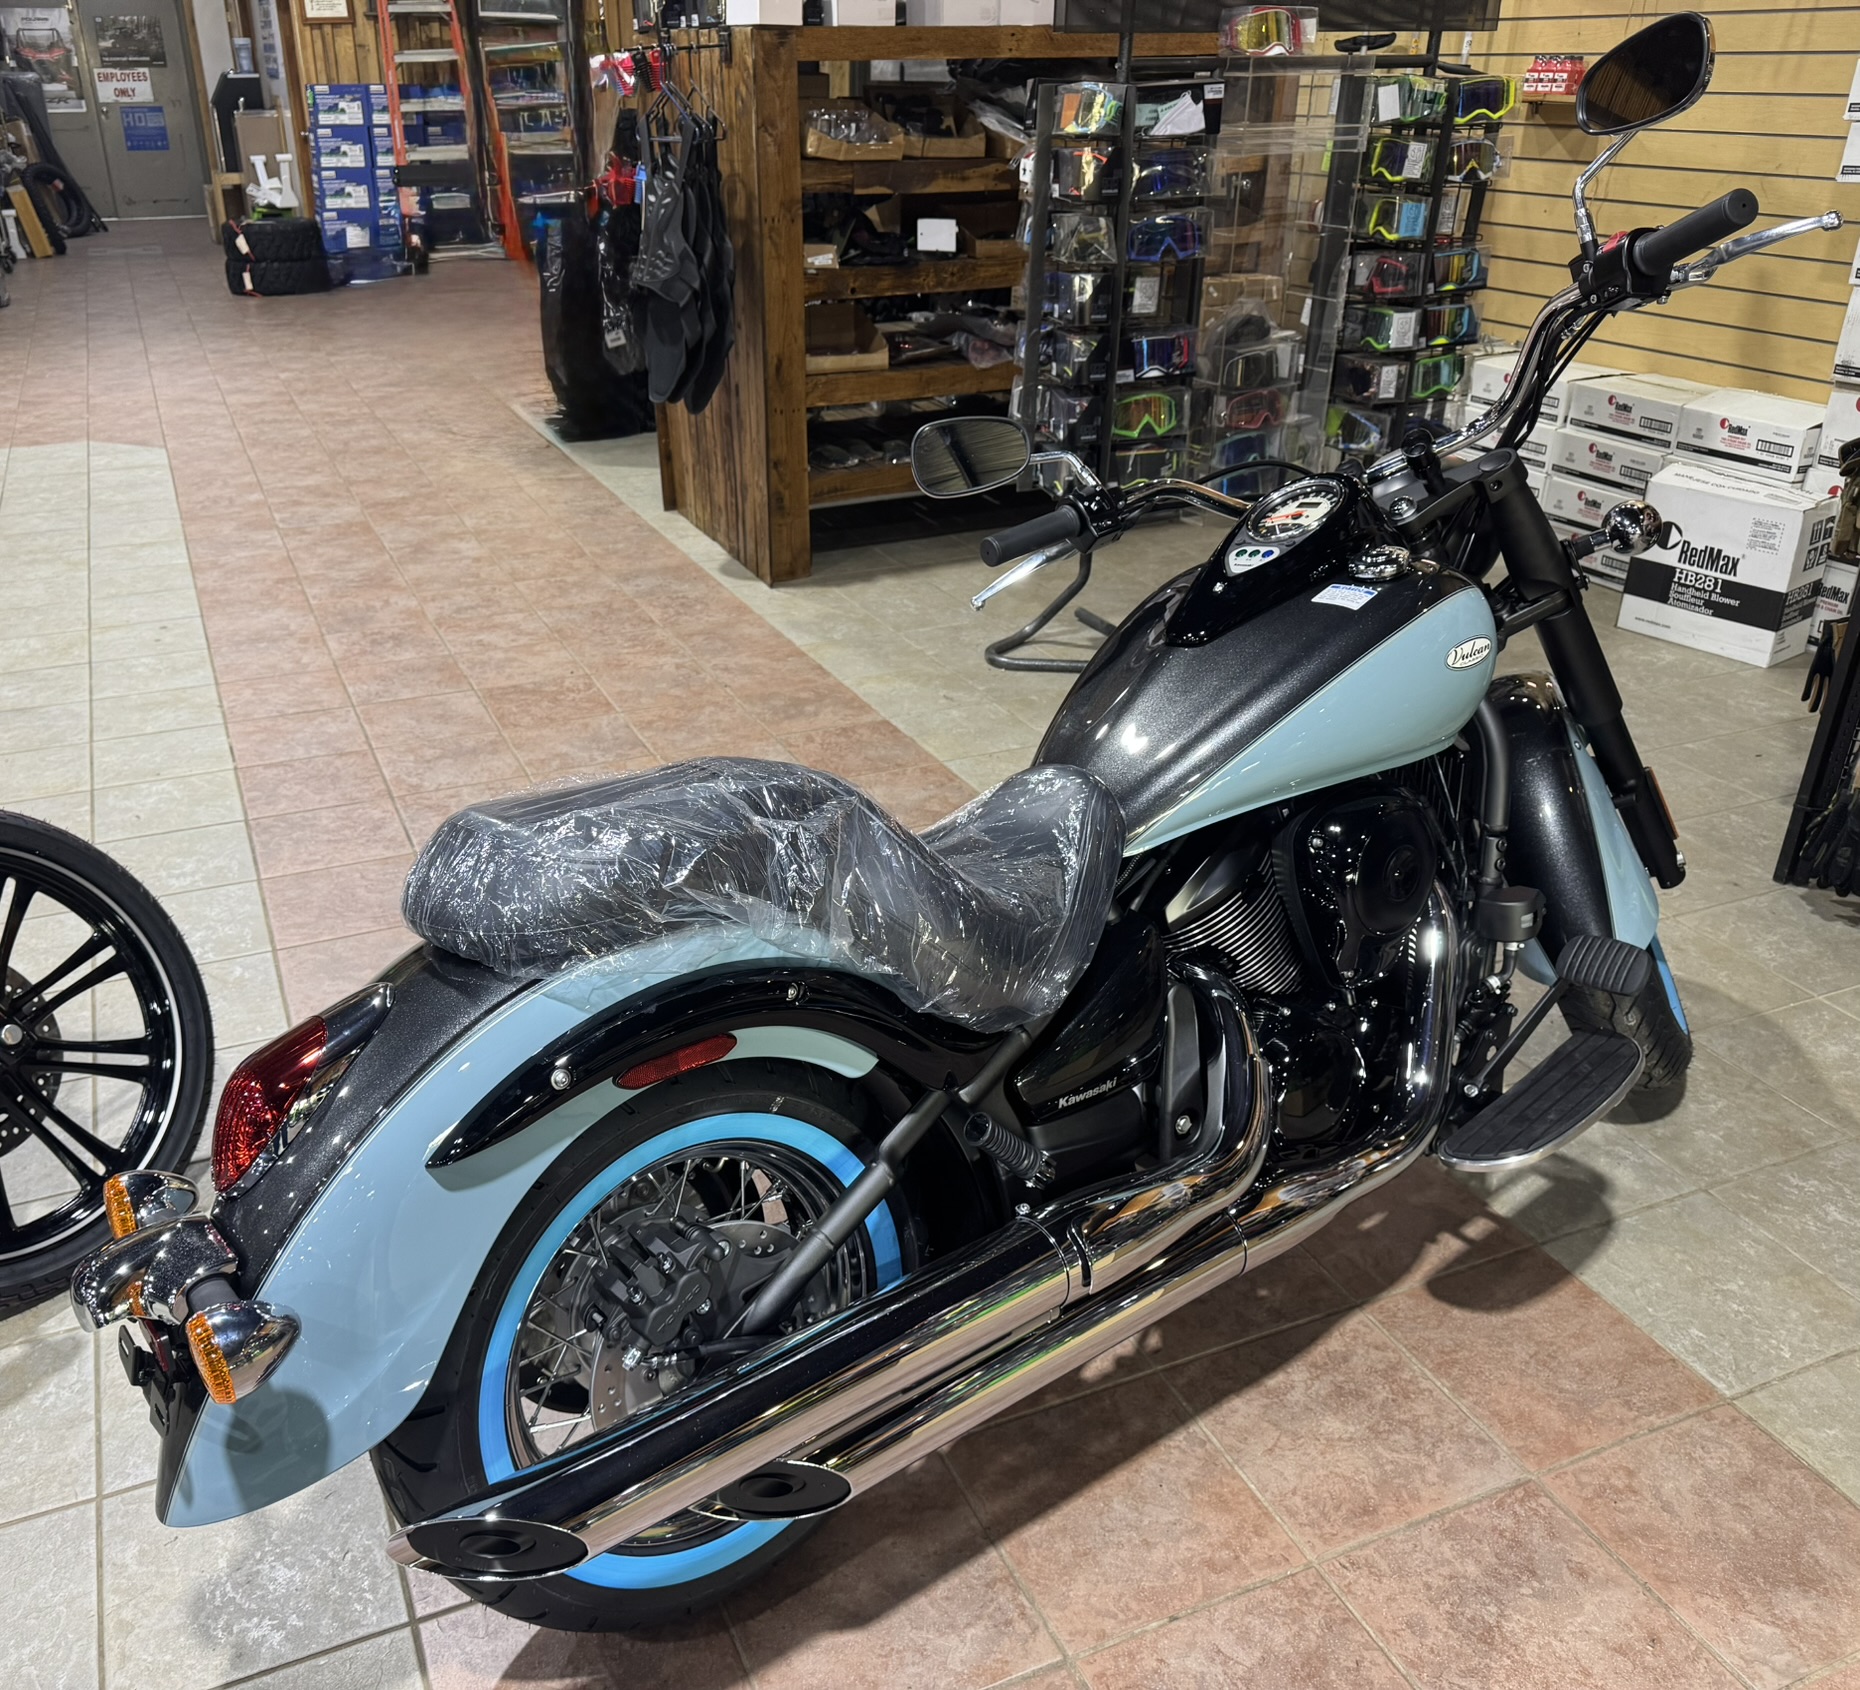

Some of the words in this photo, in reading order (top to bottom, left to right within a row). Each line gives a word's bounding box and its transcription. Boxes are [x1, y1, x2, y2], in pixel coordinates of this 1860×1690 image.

[97, 71, 148, 82] EMPLOYEES
[113, 87, 136, 98] ONLY
[1677, 539, 1741, 577] RedMax
[1672, 568, 1723, 593] HB281
[1668, 590, 1705, 606] Souffleur
[1670, 582, 1709, 600] Handheld
[1711, 593, 1740, 607] Blower
[1819, 582, 1850, 604] RedMax
[1667, 598, 1714, 616] Atomizador
[1452, 641, 1490, 666] Vulcan
[1058, 1076, 1117, 1109] Kawasaki
